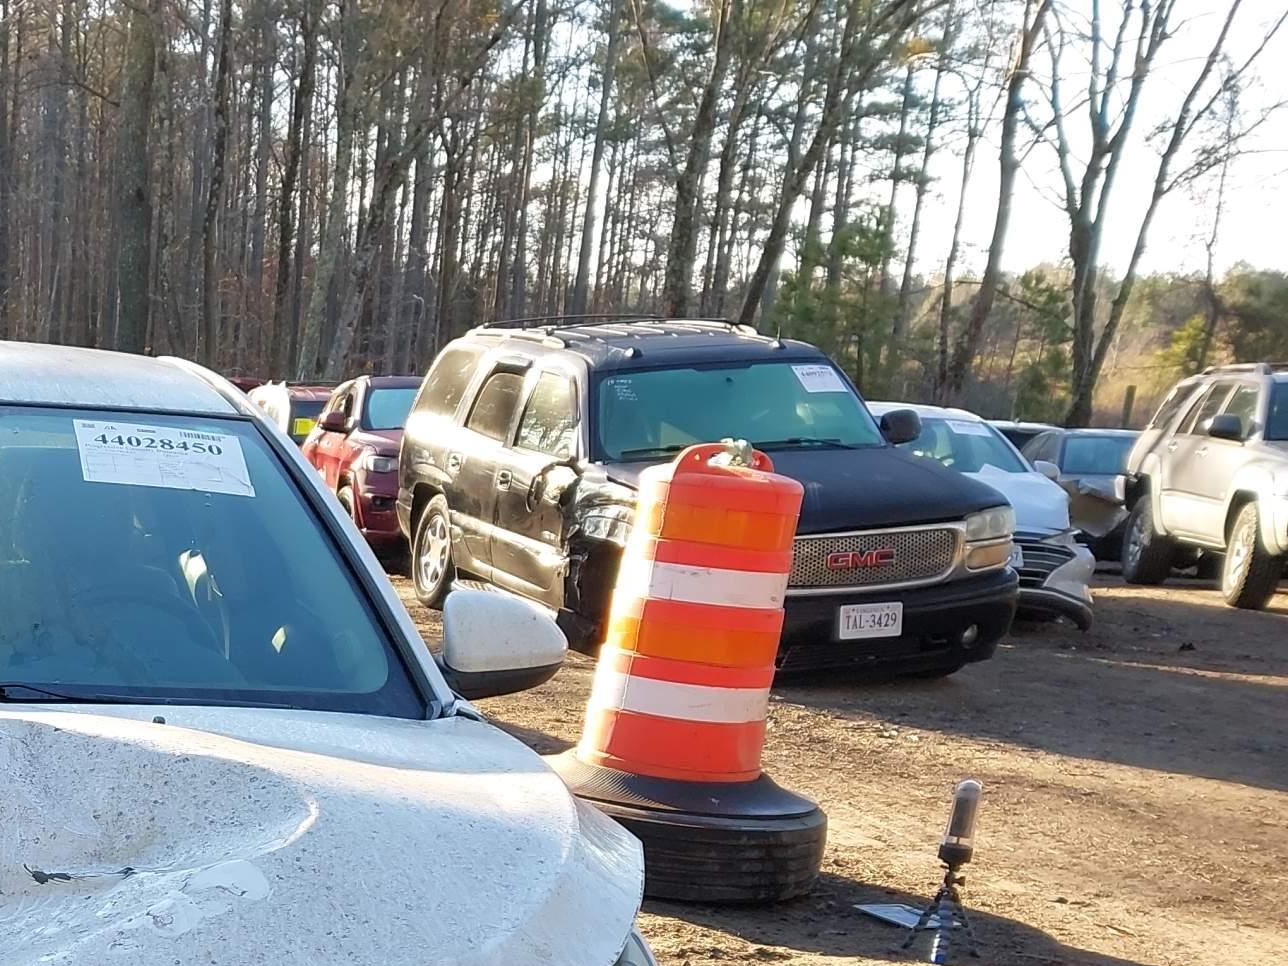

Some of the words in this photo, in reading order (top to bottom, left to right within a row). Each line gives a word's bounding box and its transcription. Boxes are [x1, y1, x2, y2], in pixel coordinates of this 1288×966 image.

[94, 434, 223, 455] 44028450
[827, 549, 896, 570] GMC
[845, 612, 897, 630] TAL-3429
